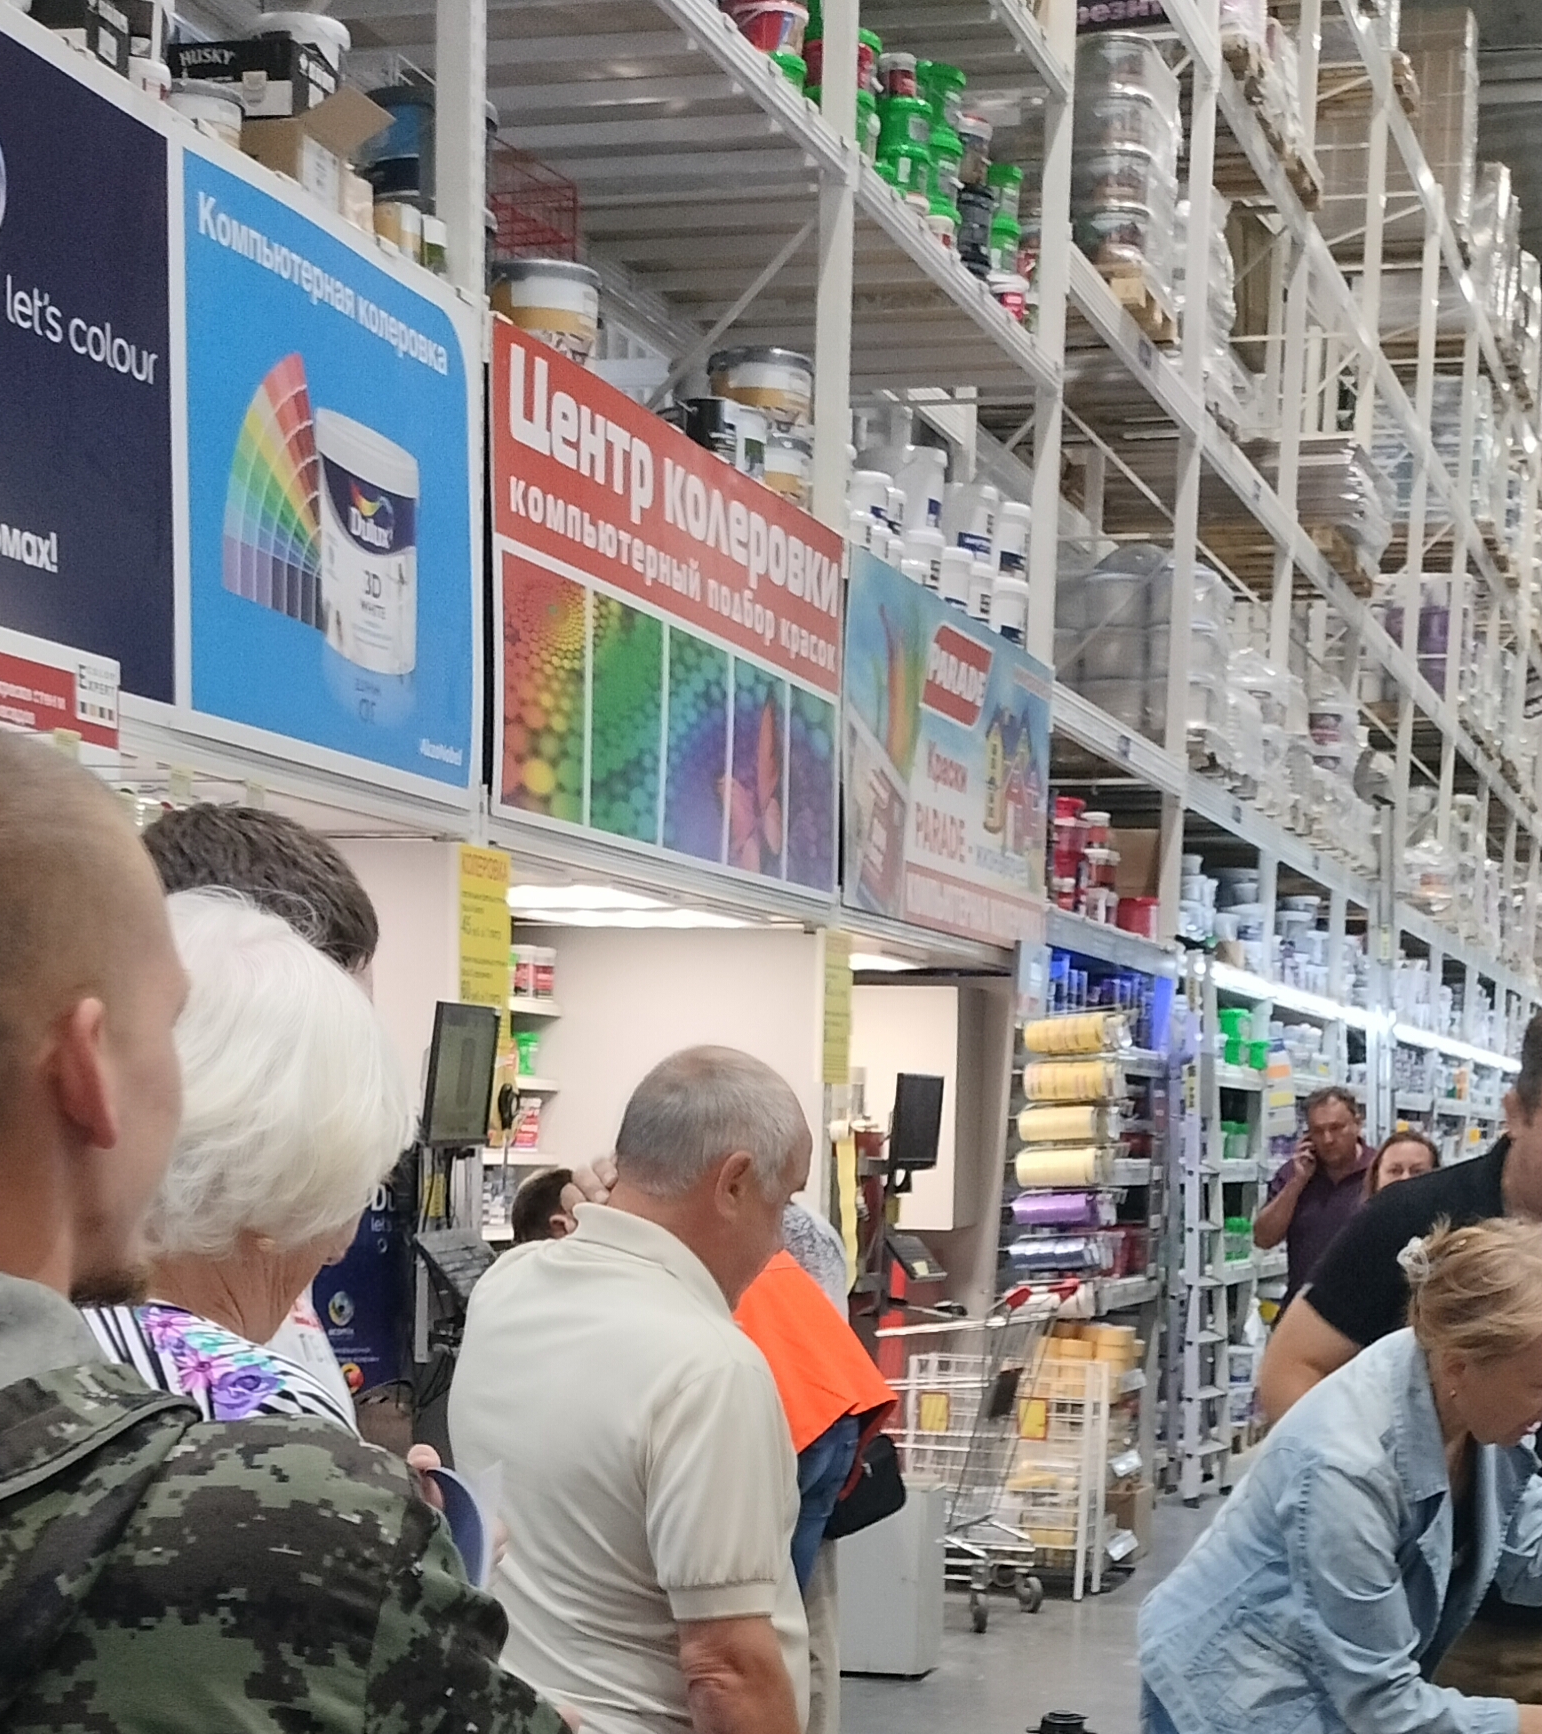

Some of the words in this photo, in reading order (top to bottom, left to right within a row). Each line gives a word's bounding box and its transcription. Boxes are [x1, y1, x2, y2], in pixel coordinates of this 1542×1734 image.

[179, 49, 236, 67] HUSKY
[6, 275, 63, 345] let's
[70, 320, 159, 385] colour
[198, 191, 355, 322] Компьютерная
[359, 288, 449, 376] колеровка
[349, 507, 393, 549] Dulux
[510, 342, 654, 525] Центр
[663, 456, 838, 618] колеровки
[364, 570, 381, 599] 3D
[510, 476, 700, 602] компьютерный
[708, 578, 775, 644] подбор
[780, 617, 836, 671] красок
